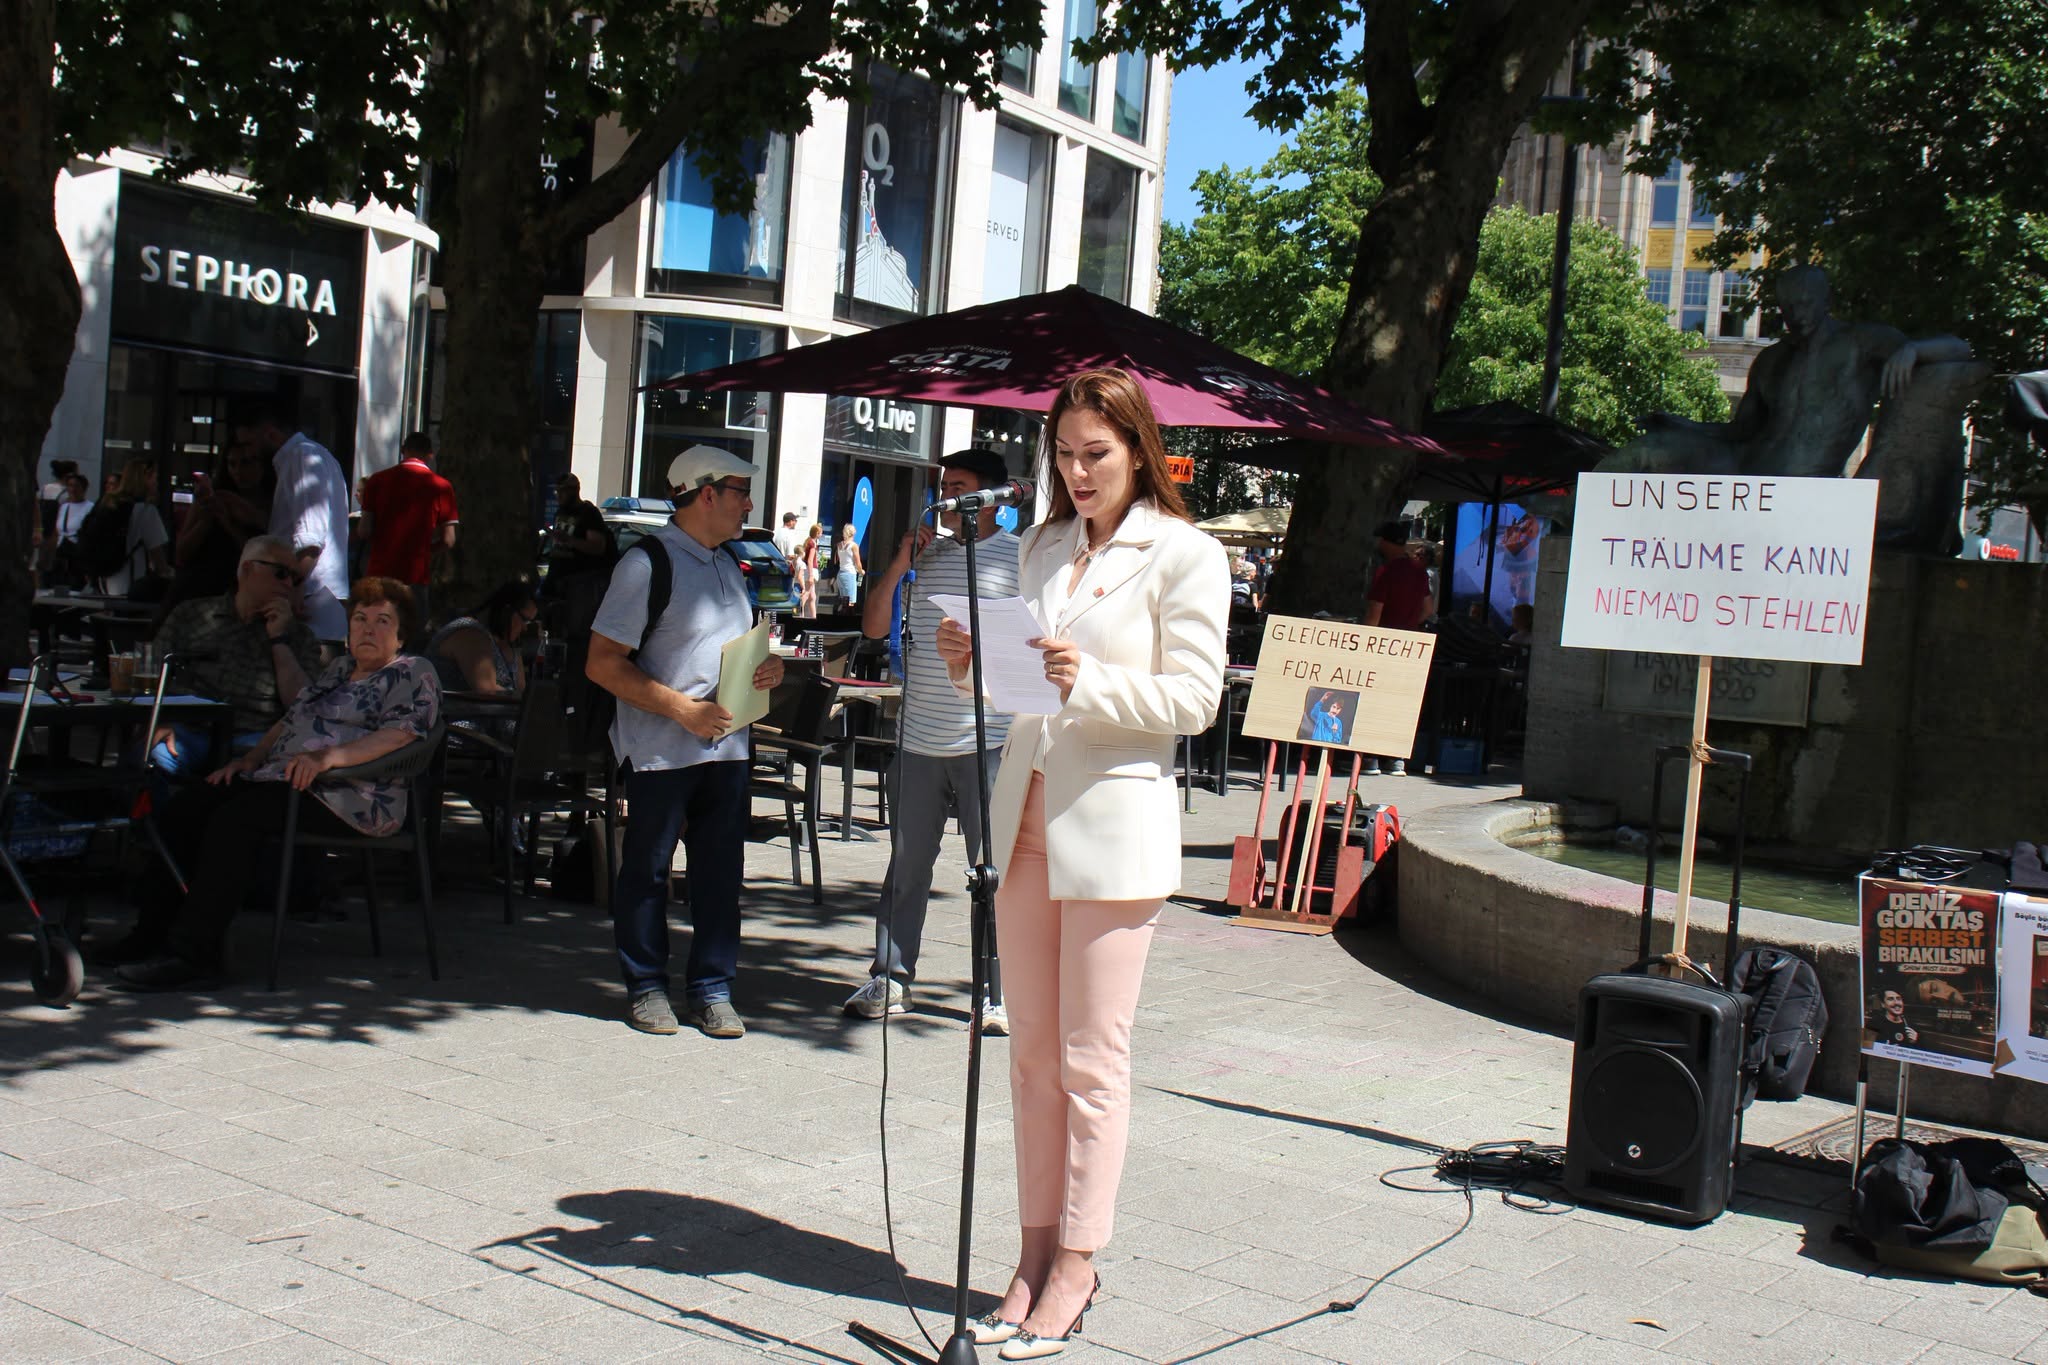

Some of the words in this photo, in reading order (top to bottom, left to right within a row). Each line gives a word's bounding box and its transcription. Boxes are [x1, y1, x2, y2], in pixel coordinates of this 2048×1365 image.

[140, 246, 337, 316] SEPHORA
[889, 351, 1013, 371] COSTA
[877, 399, 916, 433] Live
[1612, 479, 1776, 512] UNSERE
[1602, 537, 1745, 572] TRÄUME
[1765, 546, 1849, 577] KANN
[1715, 595, 1861, 635] STEHLEN
[1271, 624, 1361, 651] GLEICHES
[1366, 636, 1431, 659] RECHT
[1283, 660, 1322, 682] FÜR
[1330, 667, 1376, 688] ALLE
[1879, 929, 1985, 948] SERBEST
[1879, 946, 1986, 965] BIRAKILSIN!
